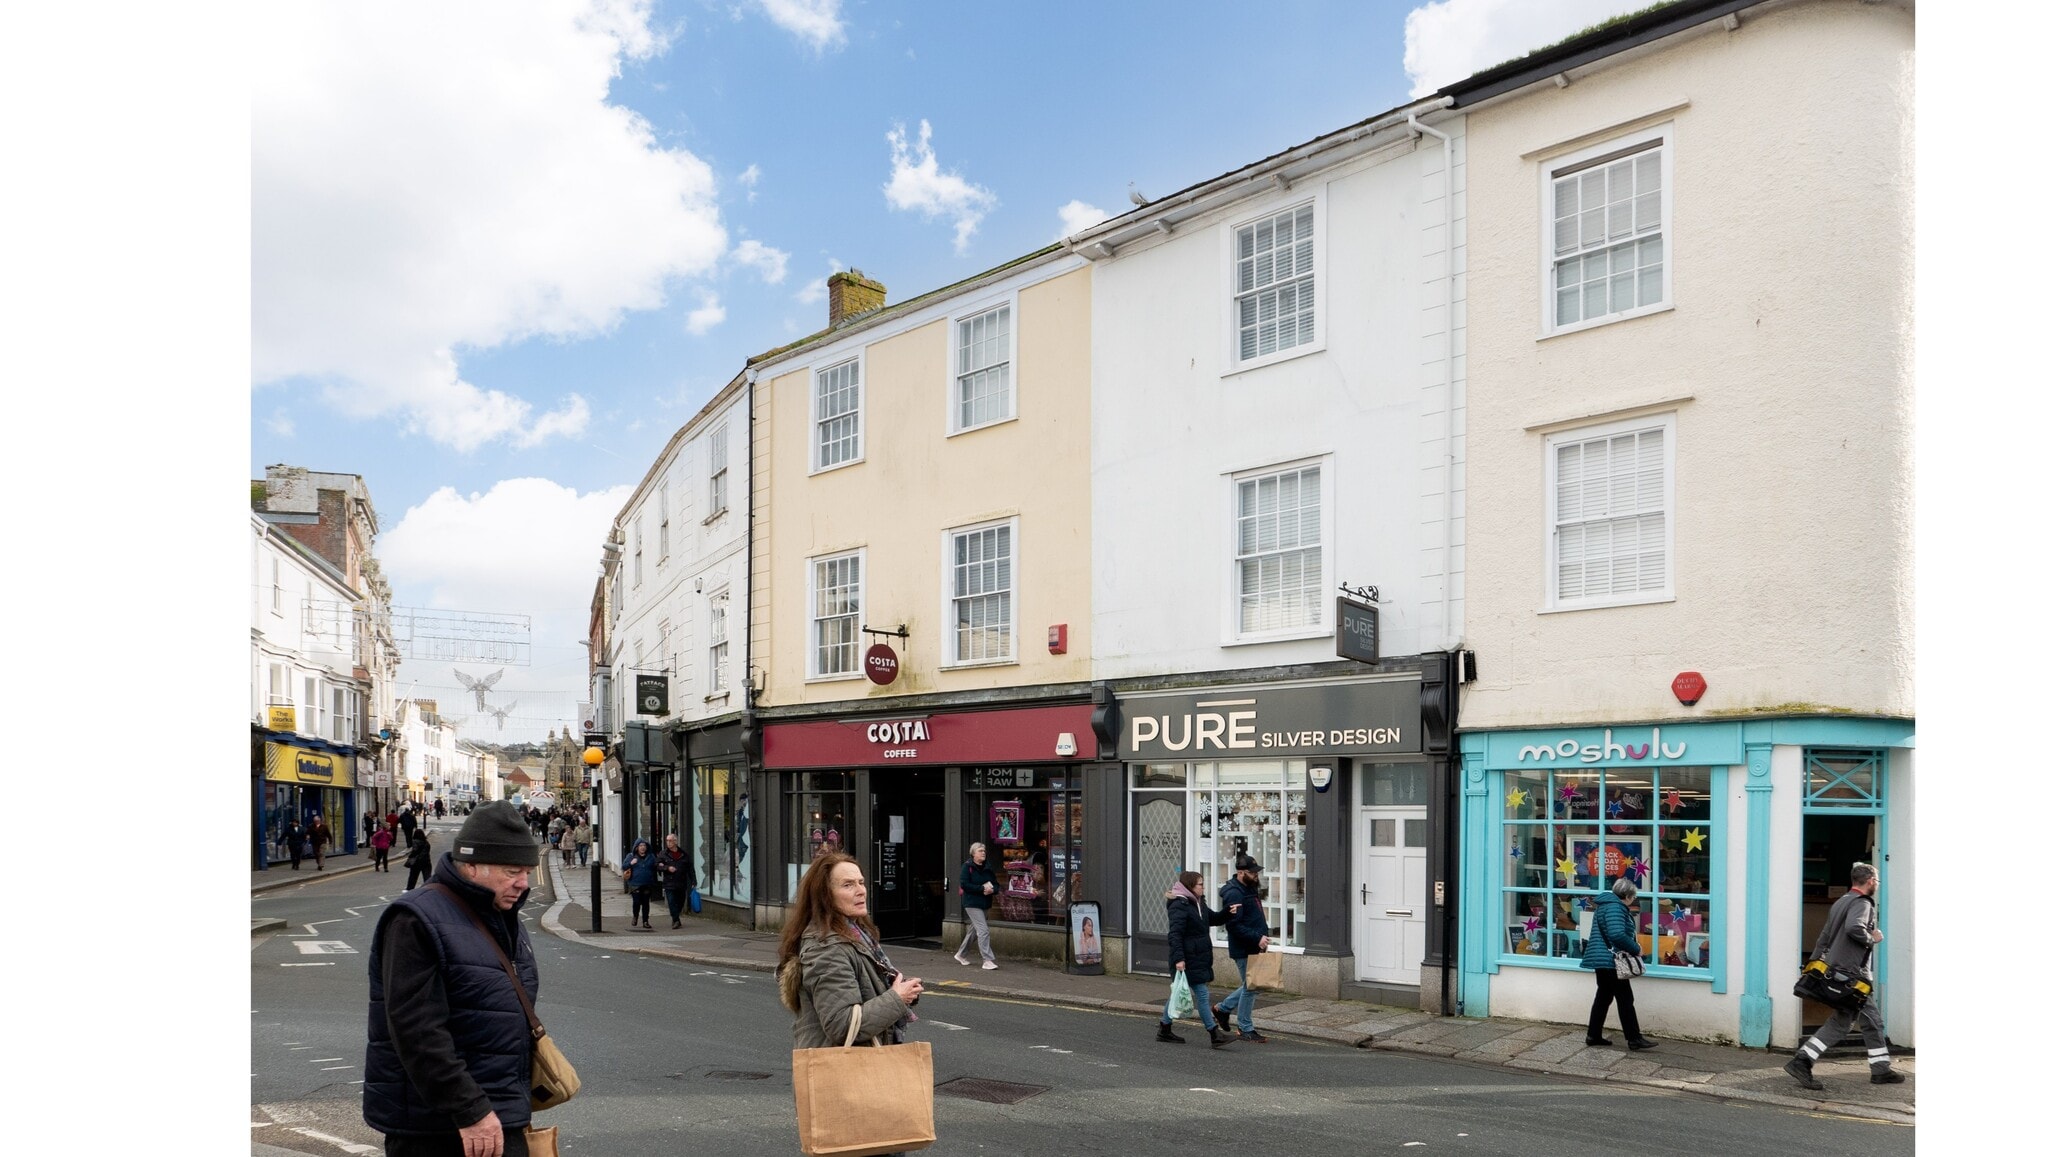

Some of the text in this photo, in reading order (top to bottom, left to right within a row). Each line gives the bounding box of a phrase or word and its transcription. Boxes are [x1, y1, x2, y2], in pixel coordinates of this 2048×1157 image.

[1344, 617, 1374, 639] PURE
[869, 656, 896, 668] COSTA
[867, 721, 930, 744] COSTA
[1132, 699, 1401, 752] PURE SILVER DESIGN
[884, 749, 917, 758] COFFEE
[1518, 727, 1686, 763] moshulu
